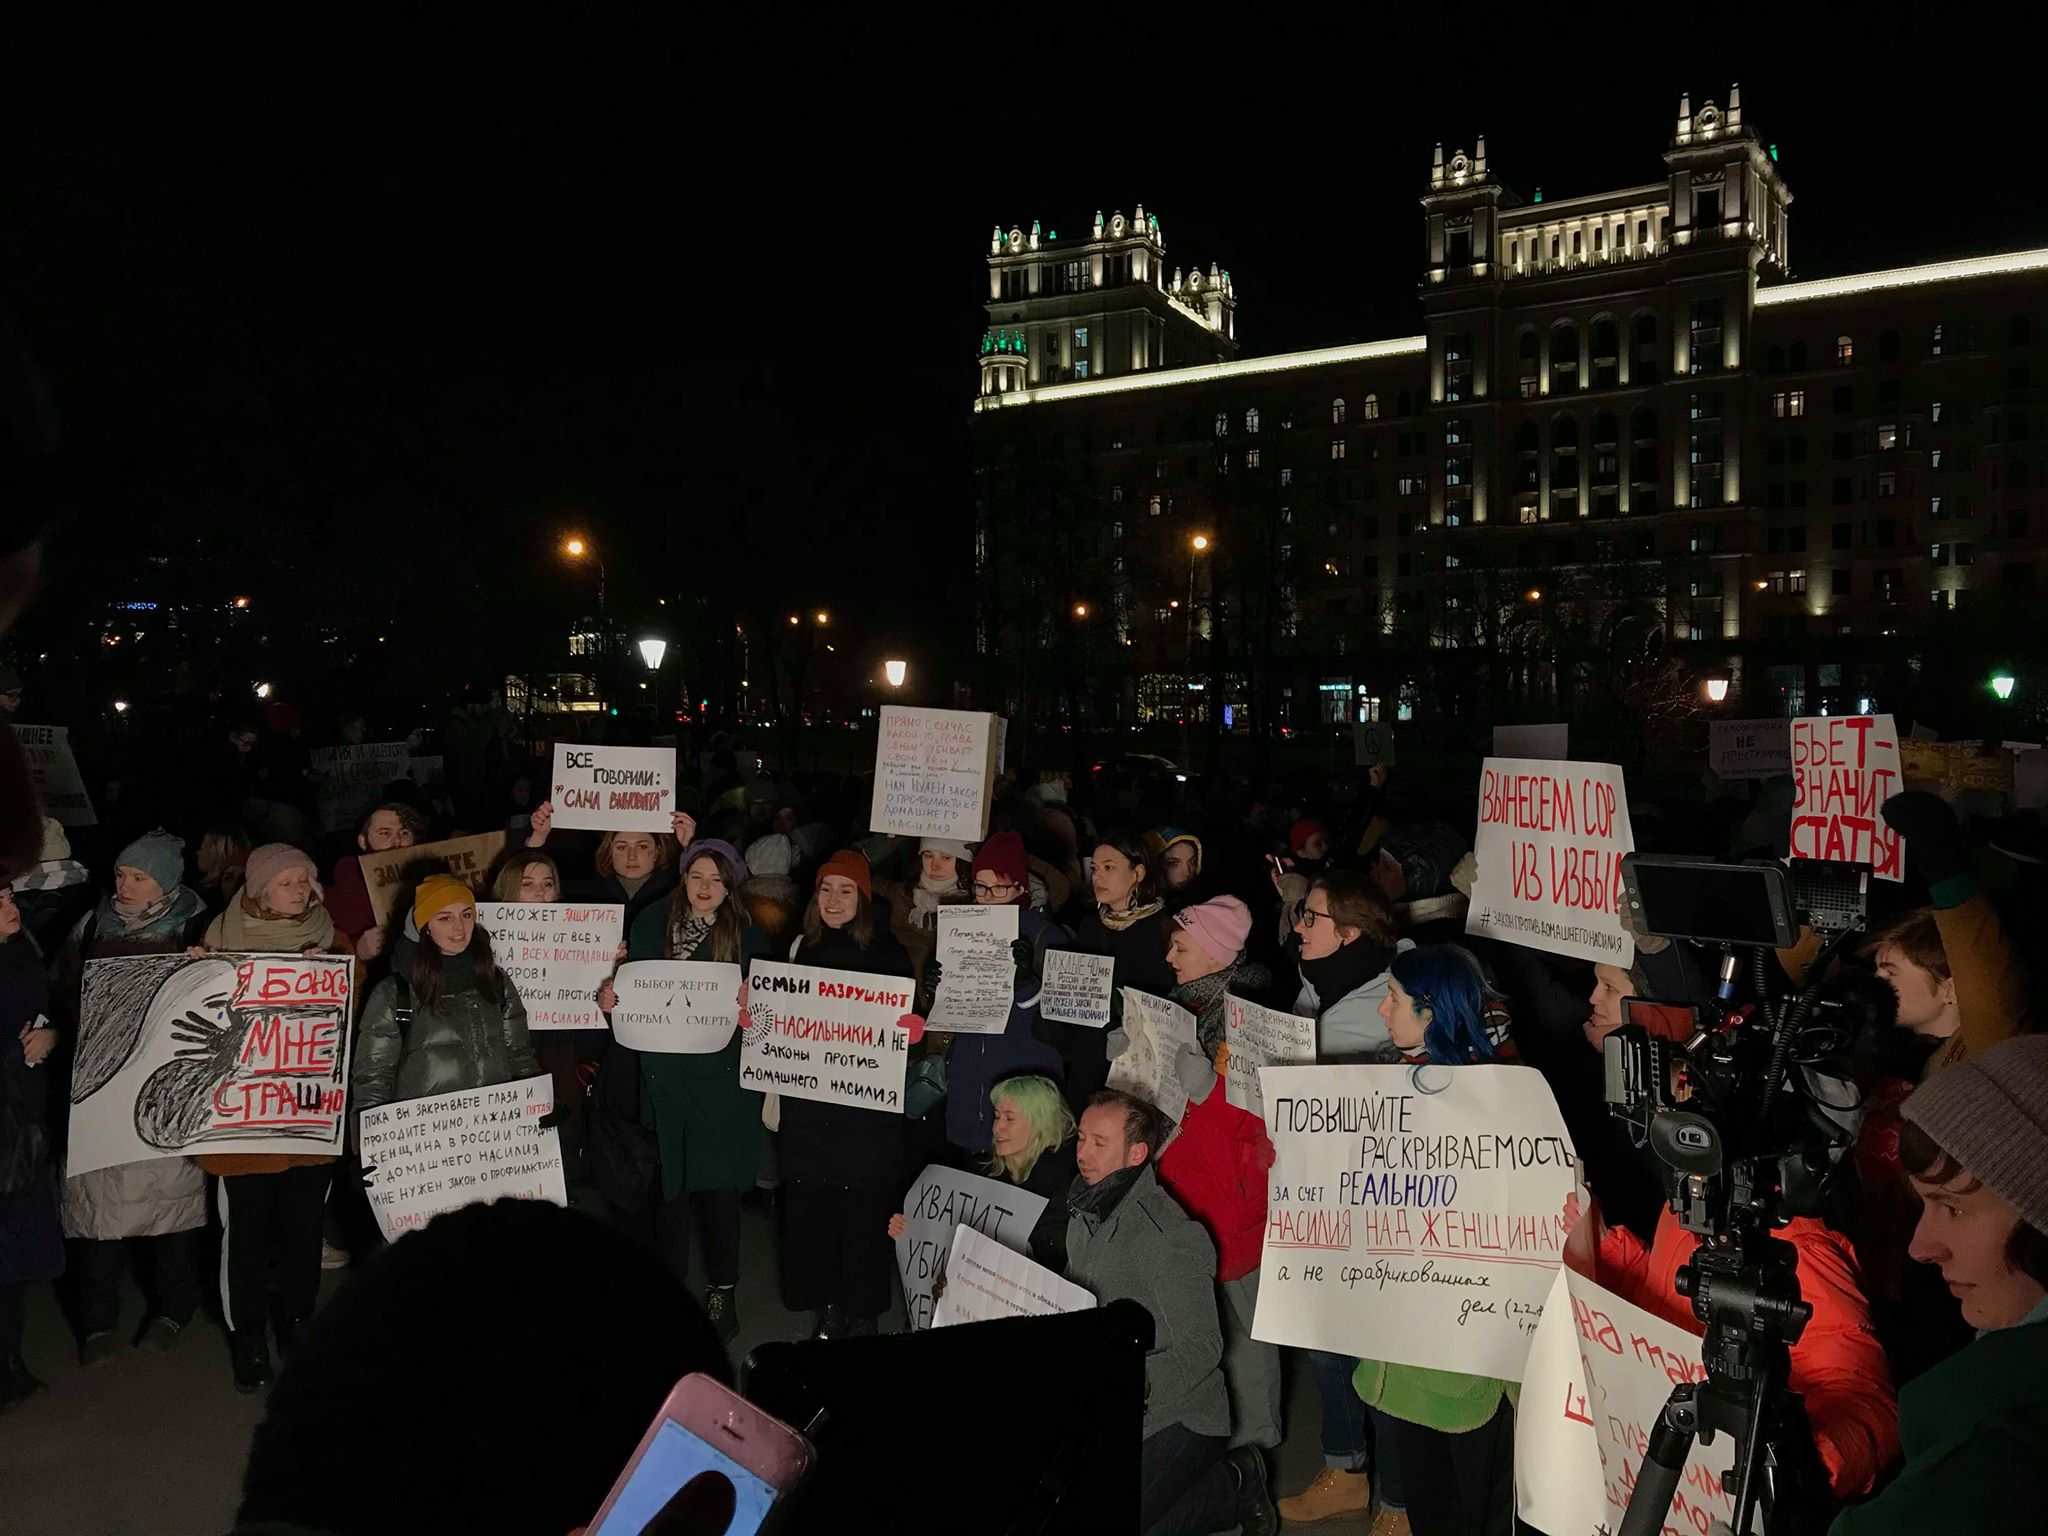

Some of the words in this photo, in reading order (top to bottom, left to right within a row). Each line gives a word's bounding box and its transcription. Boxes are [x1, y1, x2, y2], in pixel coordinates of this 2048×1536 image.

[886, 716, 921, 728] ПРЯМО
[924, 719, 974, 734] СЕЙЧАС
[929, 745, 974, 756] УБИВАЕТ
[1736, 735, 1756, 749] НЕ
[567, 752, 594, 769] ВСЕ
[887, 754, 918, 762] СВОЮ
[926, 755, 959, 766] ЖЕНУ
[593, 768, 661, 787] ГОВОРИЛИ:
[885, 779, 905, 792] НАМ
[911, 777, 945, 795] НУЖЕН
[948, 787, 978, 798] ЗАКОН
[886, 793, 894, 803] О
[897, 793, 978, 811] ПРОФИЛАКТИКЕ
[1481, 769, 1576, 835] ВЫНЕСЕМ
[1583, 778, 1616, 839] СОР
[1792, 767, 1896, 818] ЗНАЧИТ
[882, 804, 959, 820] ДОМАШНЕГО
[888, 818, 951, 834] НАСИЛИЯ
[1790, 814, 1900, 879] СТАТЬЯ
[1512, 841, 1543, 902] ИЗ
[1550, 845, 1622, 915] ИЗБЫ!
[496, 906, 557, 922] СМОЖЕТ
[562, 907, 618, 923] ЗАЩИТИТЬ
[553, 932, 568, 944] ОТ
[571, 932, 601, 944] ВСЕХ
[506, 946, 514, 961] А
[522, 946, 549, 960] ВСЕХ
[1087, 956, 1100, 977] 40
[232, 961, 255, 1000] Я
[633, 978, 675, 990] ВЫБОР
[678, 979, 719, 992] ЖЕРТВ
[518, 985, 551, 1000] ЗАКОН
[557, 988, 598, 1002] ПРОТИВ
[818, 981, 911, 1009] РАЗРУШАЮТ
[1053, 996, 1074, 1008] НУЖЕН
[1074, 998, 1092, 1008] ЗАКОН
[535, 1009, 599, 1027] НАСИЛИЯ!
[619, 1012, 672, 1025] ТЮРЬМА
[686, 1015, 731, 1026] СМЕРТЬ
[1299, 1021, 1310, 1035] ЗА
[241, 1015, 336, 1071] МНЕ
[877, 1028, 885, 1048] А
[892, 1030, 908, 1052] НЕ
[1283, 1046, 1292, 1056] ОТ
[761, 1042, 810, 1062] ЗАКОНЫ
[824, 1051, 880, 1069] ПРОТИВ
[742, 1065, 818, 1090] ДОМАШНЕГО
[830, 1079, 898, 1107] НАСИЛИЯ
[213, 1080, 345, 1121] СТРАШНО
[364, 1111, 390, 1129] ПОКА
[416, 1095, 481, 1117] ЗАКРЫВАЕТЕ
[488, 1089, 519, 1106] ГЛАЗА
[526, 1086, 534, 1100] И
[1274, 1091, 1414, 1134] ПОВЫШАЙТЕ
[363, 1123, 426, 1148] ПРОХОДИТЕ
[432, 1116, 469, 1133] МИМО,
[473, 1107, 521, 1126] КАЖДАЯ
[525, 1103, 552, 1116] ПЯТАЯ
[367, 1138, 442, 1166] ЖЕНЩИНА
[448, 1136, 456, 1148] В
[461, 1128, 511, 1146] РОССИИ
[1361, 1134, 1575, 1170] РАСКРЫВАЕМОСТЬ
[386, 1153, 472, 1184] ДОМАШНЕГО
[479, 1143, 540, 1163] НАСИЛИЯ
[372, 1190, 395, 1207] МНЕ
[399, 1179, 443, 1201] НУЖЕН
[447, 1174, 476, 1190] ЗАКОН
[480, 1171, 488, 1182] О
[490, 1157, 561, 1181] ПРОФИЛАКТИКЕ
[1273, 1186, 1290, 1202] ЗА
[1298, 1186, 1324, 1203] СЧЕТ
[1339, 1171, 1458, 1208] РЕАЛЬНОГО
[912, 1183, 1014, 1241] ХВАТИТ
[1268, 1209, 1352, 1246] НАСИЛИЯ
[1366, 1208, 1412, 1246] НАД
[1278, 1265, 1291, 1281] а
[1303, 1264, 1324, 1282] не
[1340, 1258, 1491, 1291] сфабрикованных
[1457, 1298, 1497, 1326] дел
